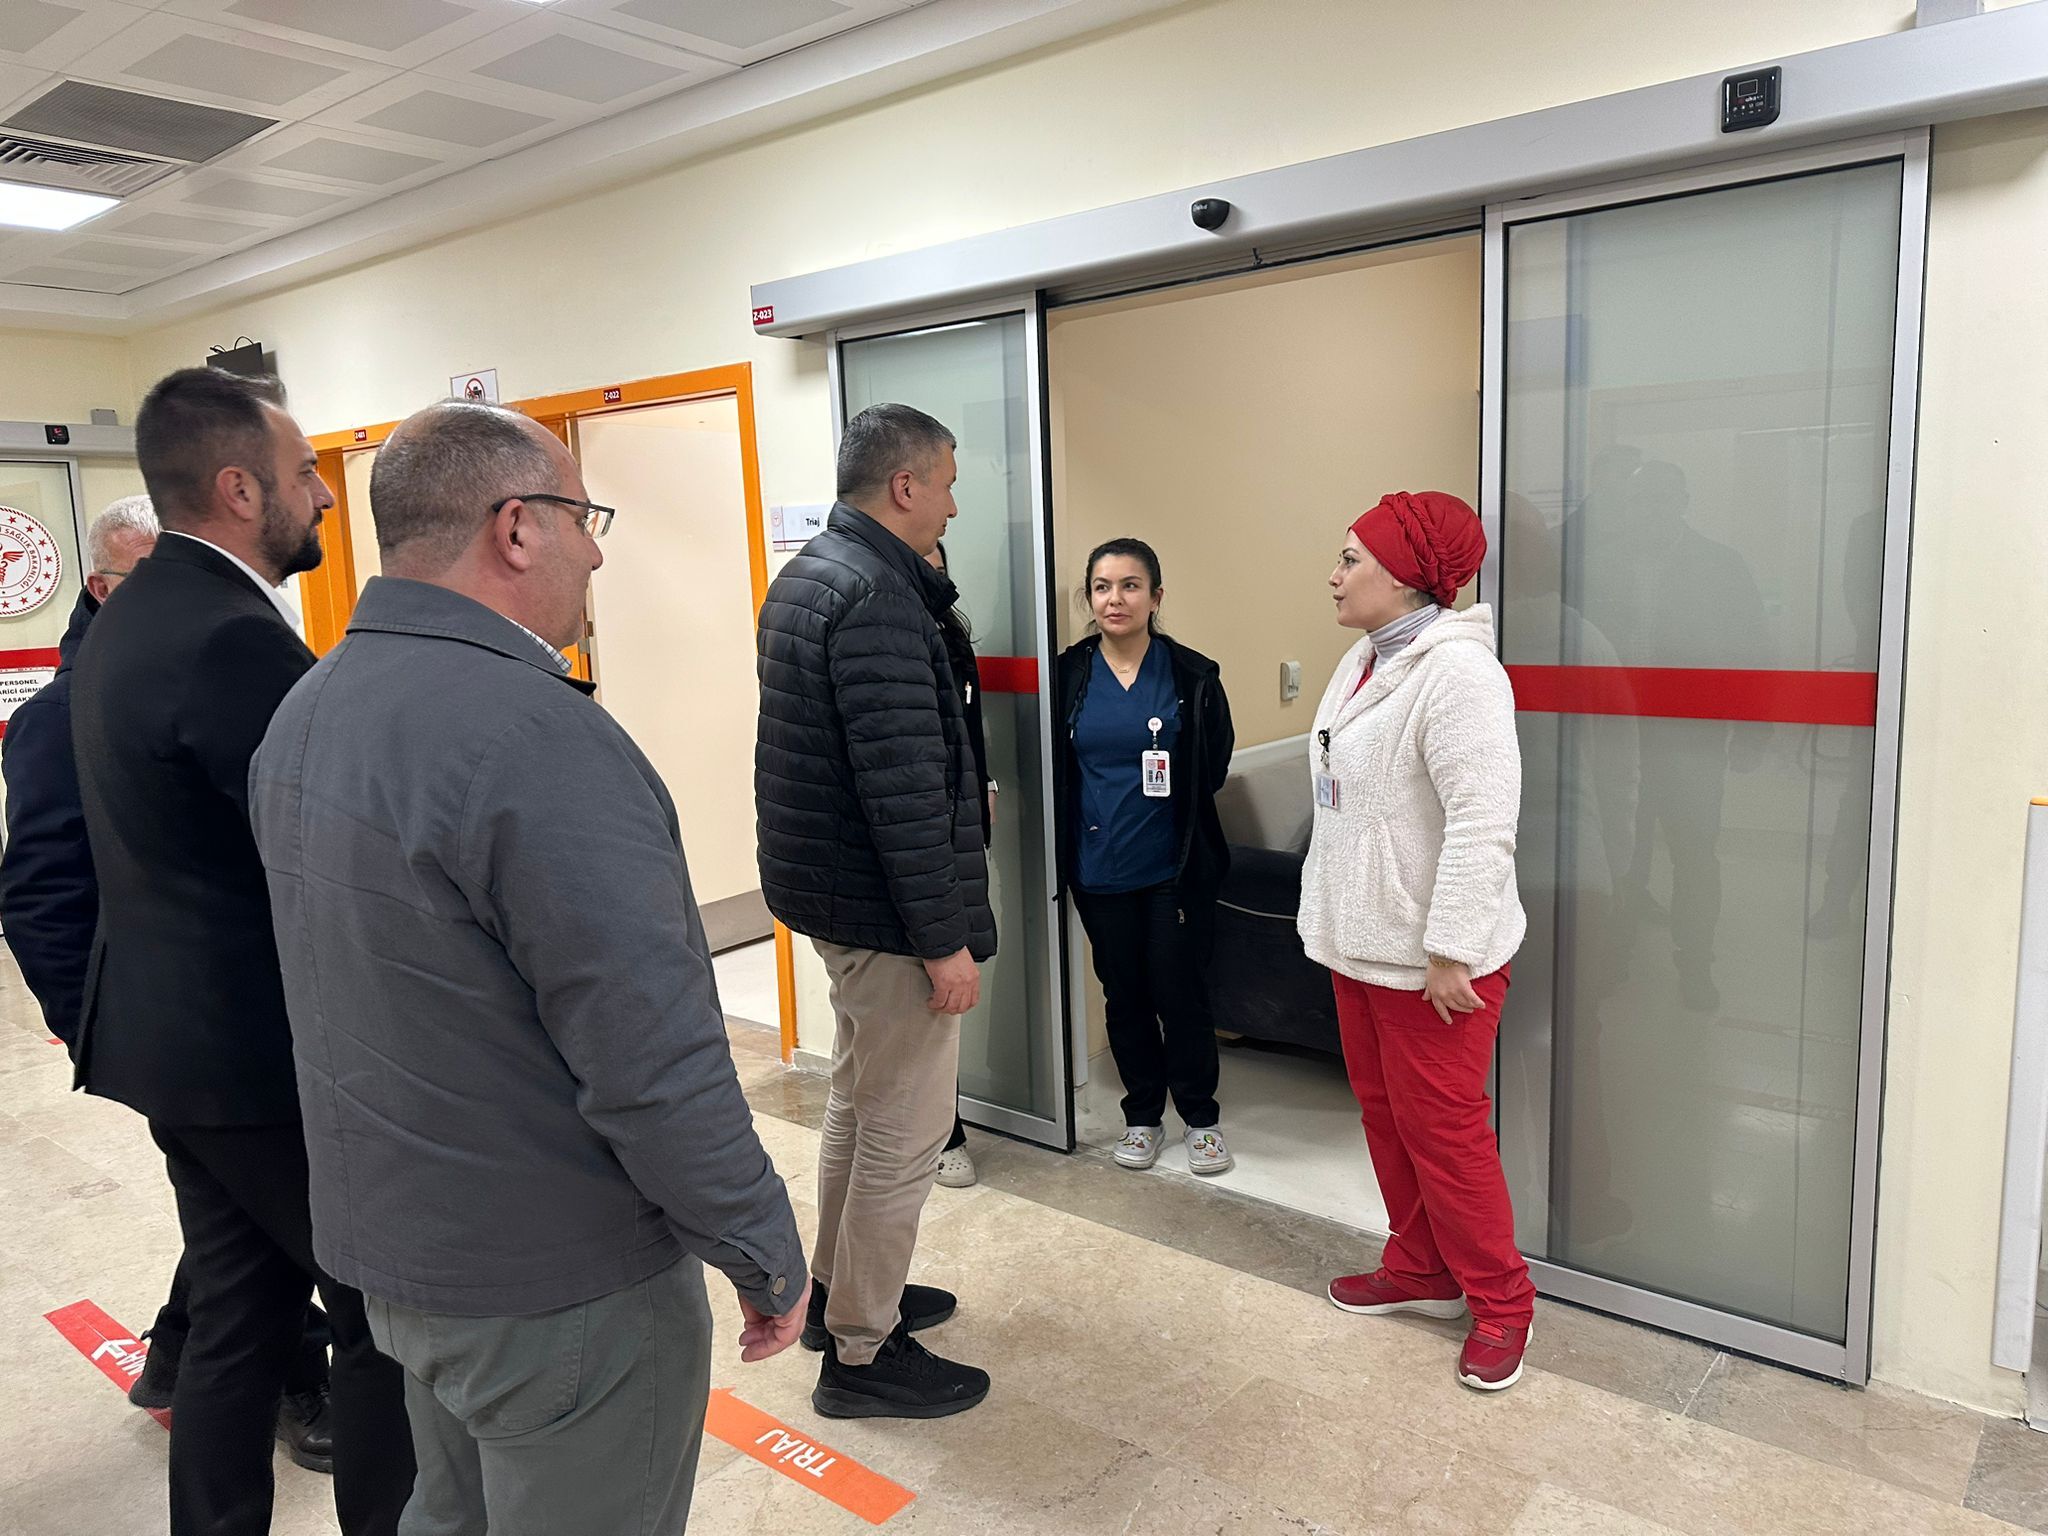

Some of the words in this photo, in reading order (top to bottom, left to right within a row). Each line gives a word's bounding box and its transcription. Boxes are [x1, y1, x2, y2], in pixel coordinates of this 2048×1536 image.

[753, 309, 772, 321] Z-023
[604, 390, 620, 401] Z-022
[805, 517, 820, 527] Triaj
[4, 528, 32, 549] SAĞLIK
[20, 549, 38, 589] BAKANLIĞI
[754, 1428, 837, 1478] TRİAJ
